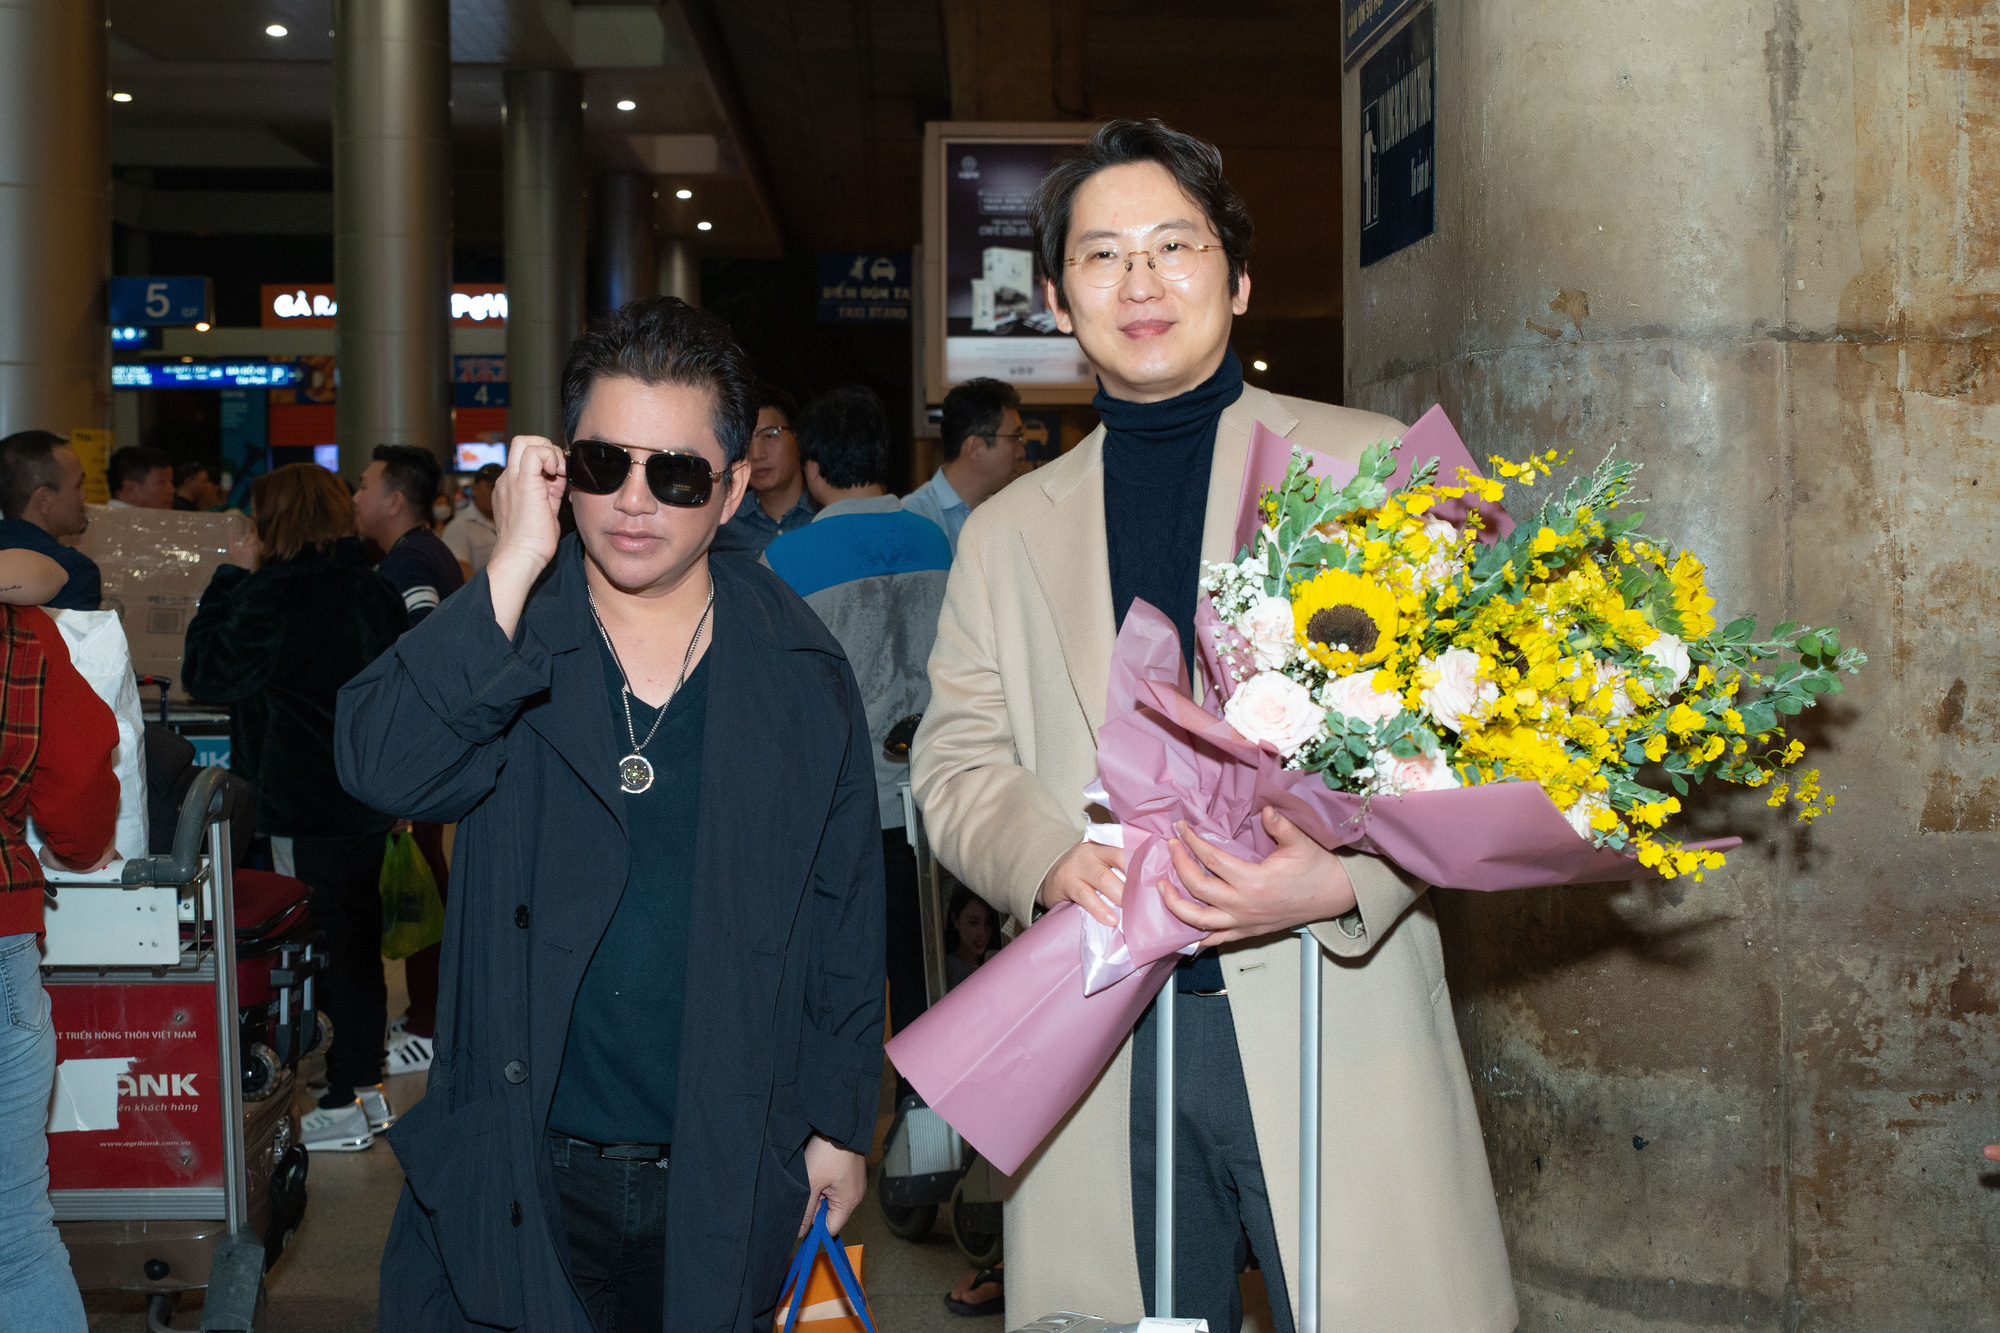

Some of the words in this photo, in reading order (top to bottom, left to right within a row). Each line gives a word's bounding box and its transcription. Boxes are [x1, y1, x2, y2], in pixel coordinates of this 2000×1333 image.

[145, 283, 170, 318] 5
[274, 290, 312, 318] GÀ
[474, 384, 488, 404] 4
[94, 1030, 121, 1040] NÔNG
[124, 1030, 149, 1040] THÔN
[152, 1030, 172, 1041] VIỆT
[174, 1030, 197, 1039] NAM
[117, 1073, 200, 1097] ANK
[118, 1103, 131, 1112] ến
[134, 1103, 167, 1112] khách
[170, 1103, 199, 1112] hàng
